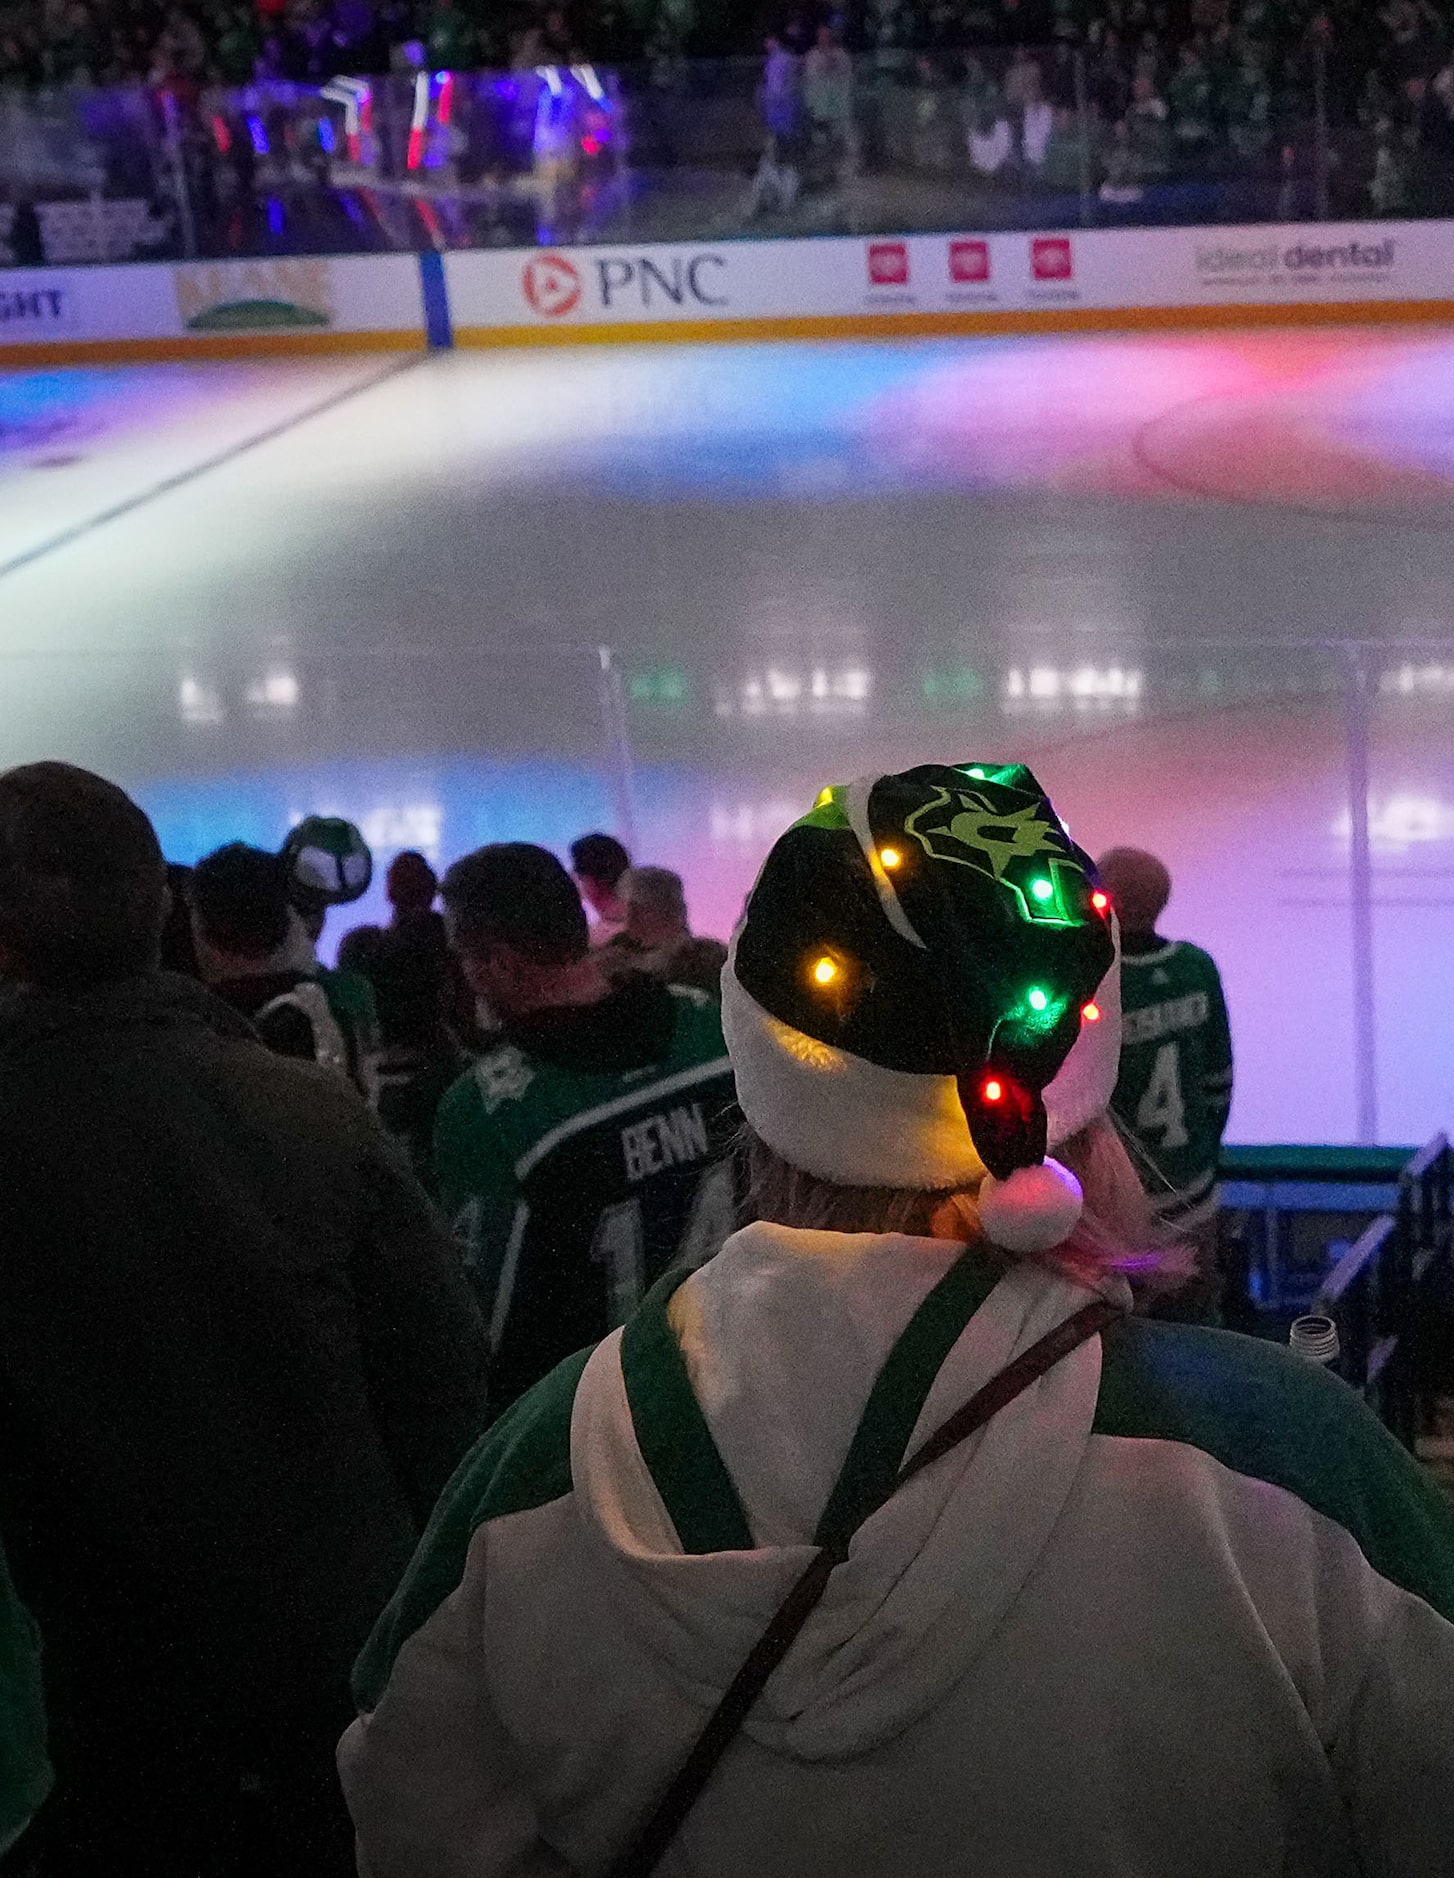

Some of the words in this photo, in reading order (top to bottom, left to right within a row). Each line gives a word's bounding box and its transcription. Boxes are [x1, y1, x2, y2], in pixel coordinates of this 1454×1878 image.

[595, 253, 730, 307] PNC
[1196, 243, 1279, 271] ideal
[1282, 237, 1396, 270] dental
[1136, 1039, 1190, 1150] 4
[620, 1099, 710, 1185] BENN
[587, 1158, 738, 1333] 14
